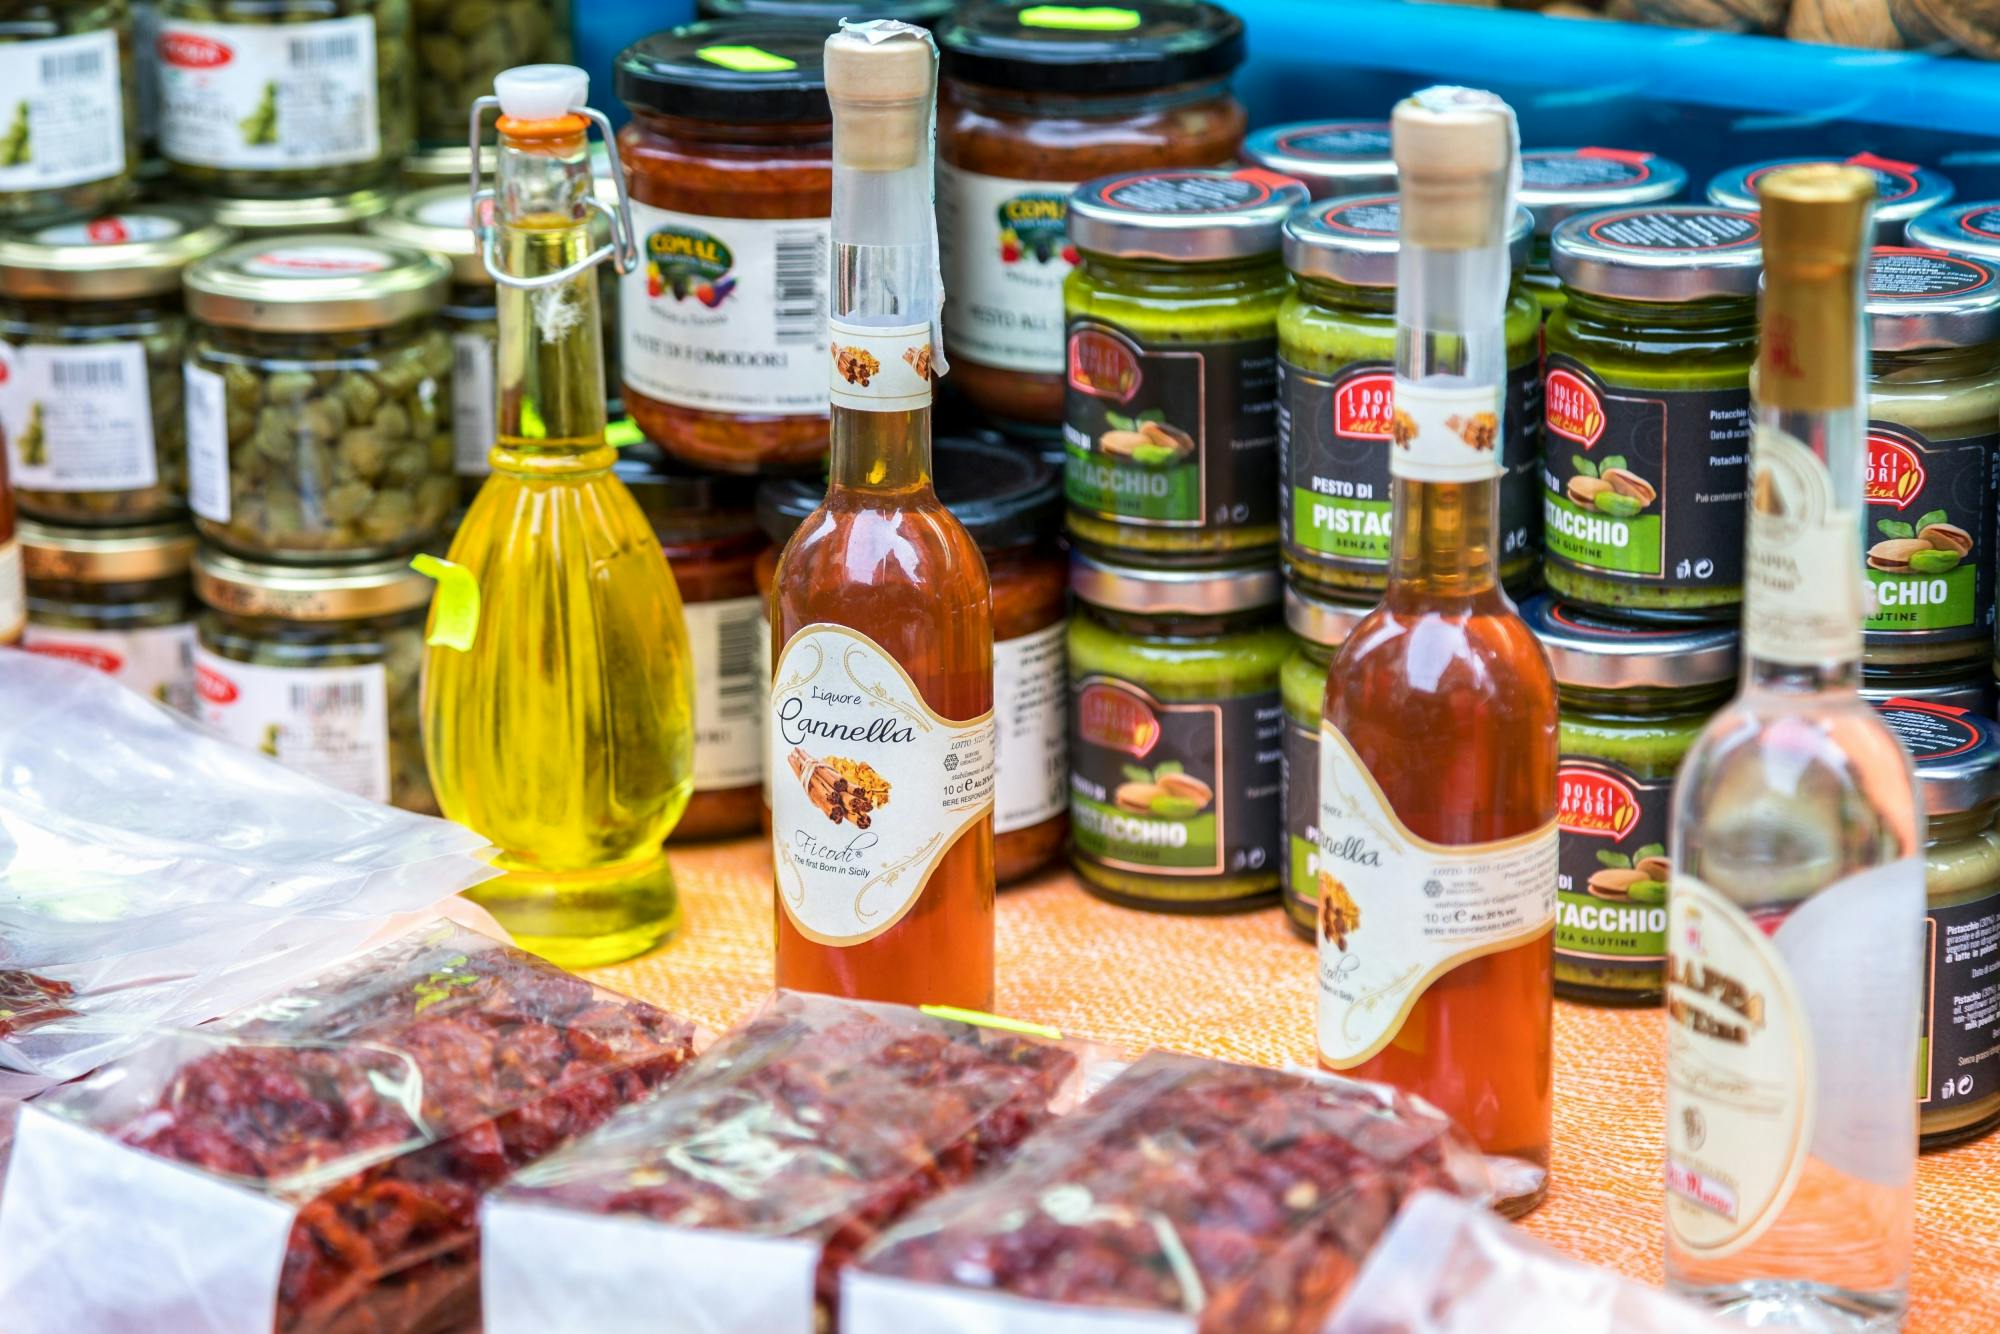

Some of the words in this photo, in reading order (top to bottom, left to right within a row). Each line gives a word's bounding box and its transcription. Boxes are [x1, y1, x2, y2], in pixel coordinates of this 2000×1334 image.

[1312, 475, 1353, 497] PESTO
[1357, 479, 1373, 499] DI
[1337, 538, 1377, 551] SENZA
[811, 685, 862, 706] Liquore
[777, 697, 916, 745] Cannella
[943, 785, 954, 795] 10
[1563, 781, 1613, 801] DOLCI
[794, 854, 805, 865] The
[805, 858, 818, 869] first
[820, 862, 837, 873] Born
[839, 865, 846, 874] in
[849, 867, 871, 878] Sicily
[1559, 875, 1572, 889] DI
[1581, 935, 1638, 948] GLUTINE
